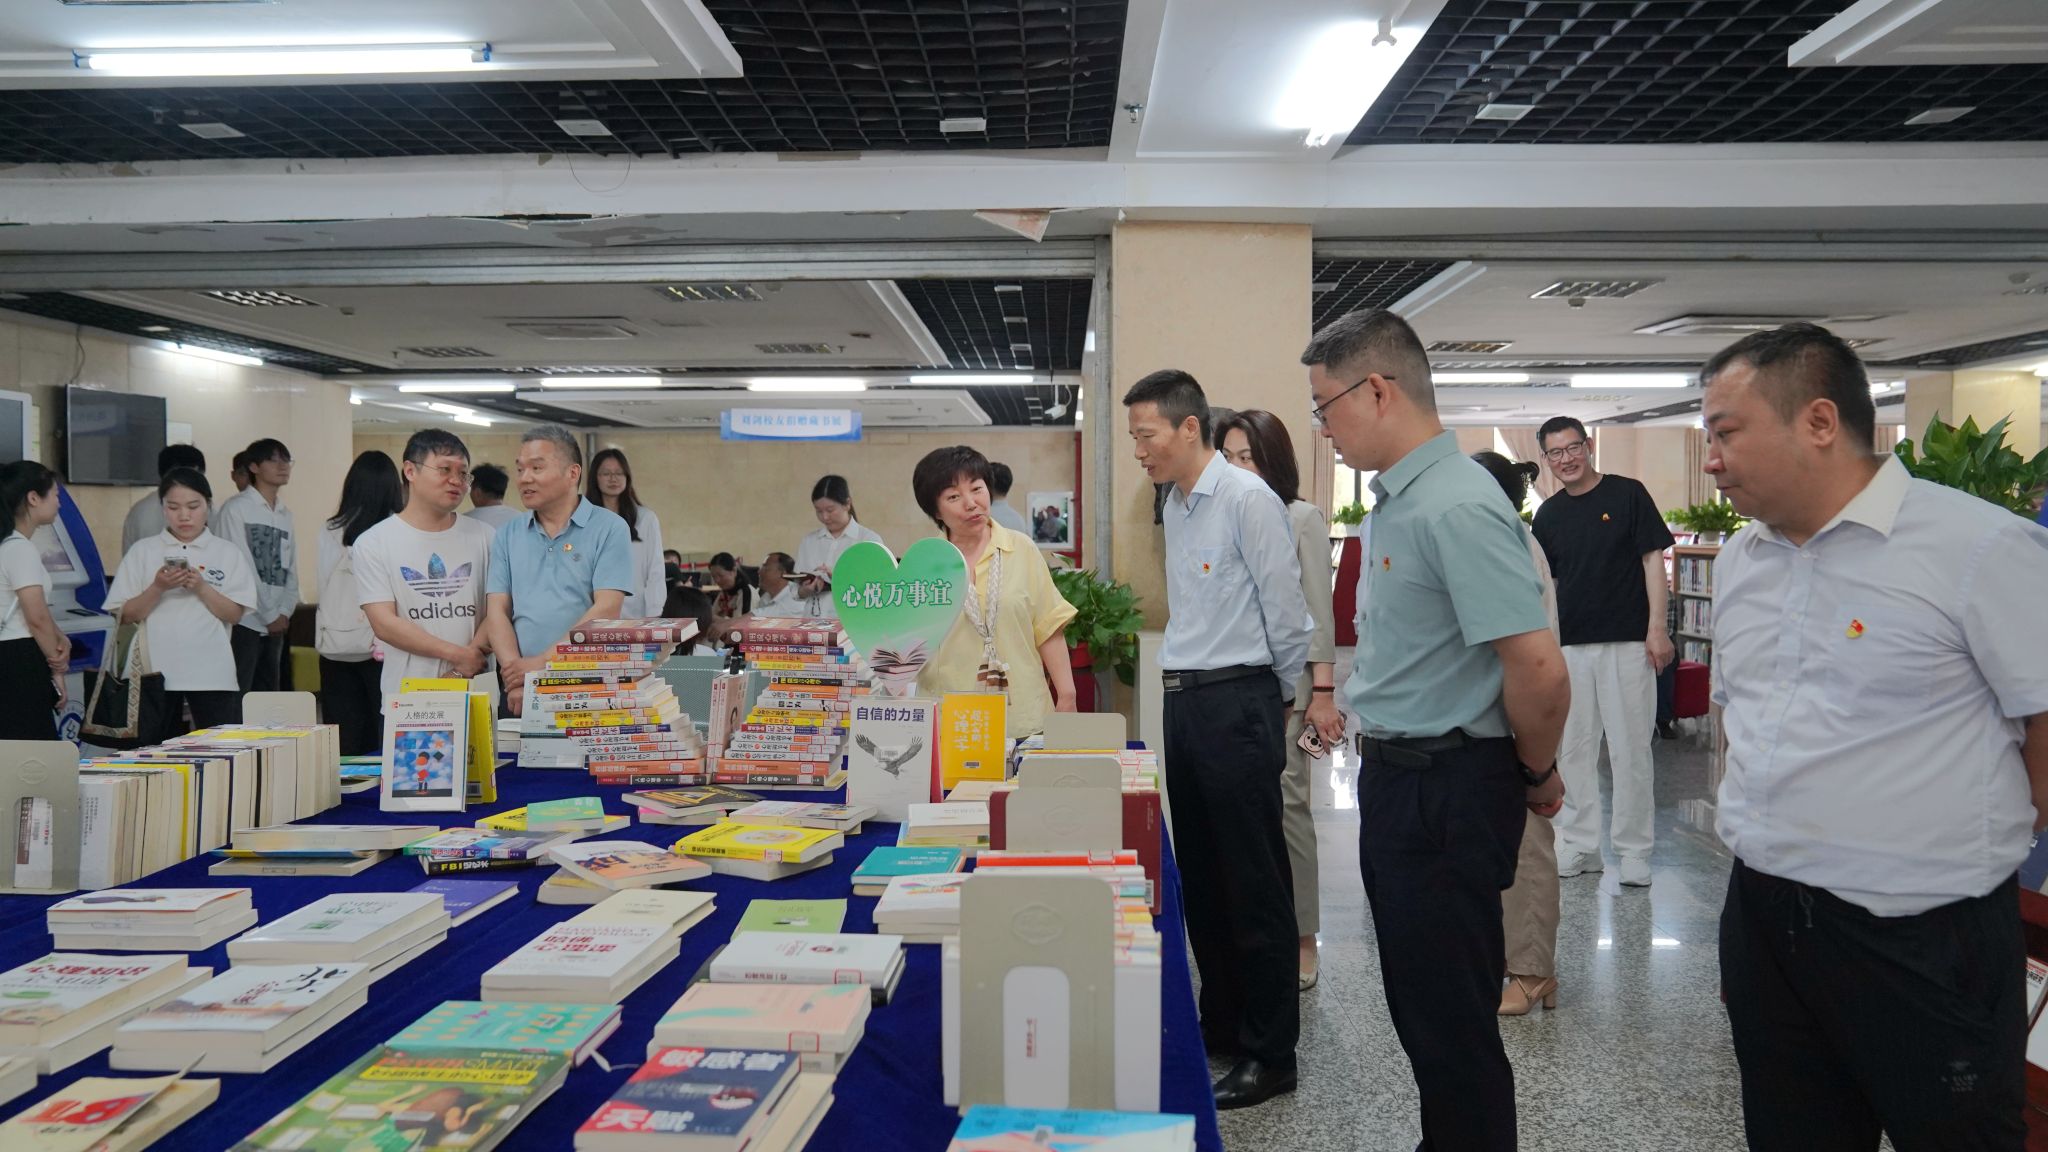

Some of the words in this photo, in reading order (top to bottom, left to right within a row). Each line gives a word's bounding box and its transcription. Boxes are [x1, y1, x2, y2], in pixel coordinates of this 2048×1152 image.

[842, 579, 952, 609] 心悦万事宜
[408, 602, 476, 620] adidas
[404, 710, 445, 719] 人格的发展
[856, 706, 925, 723] 自信的力量
[441, 862, 463, 871] FBI
[658, 1049, 786, 1071] 敏感者
[596, 1108, 694, 1132] 天赋
